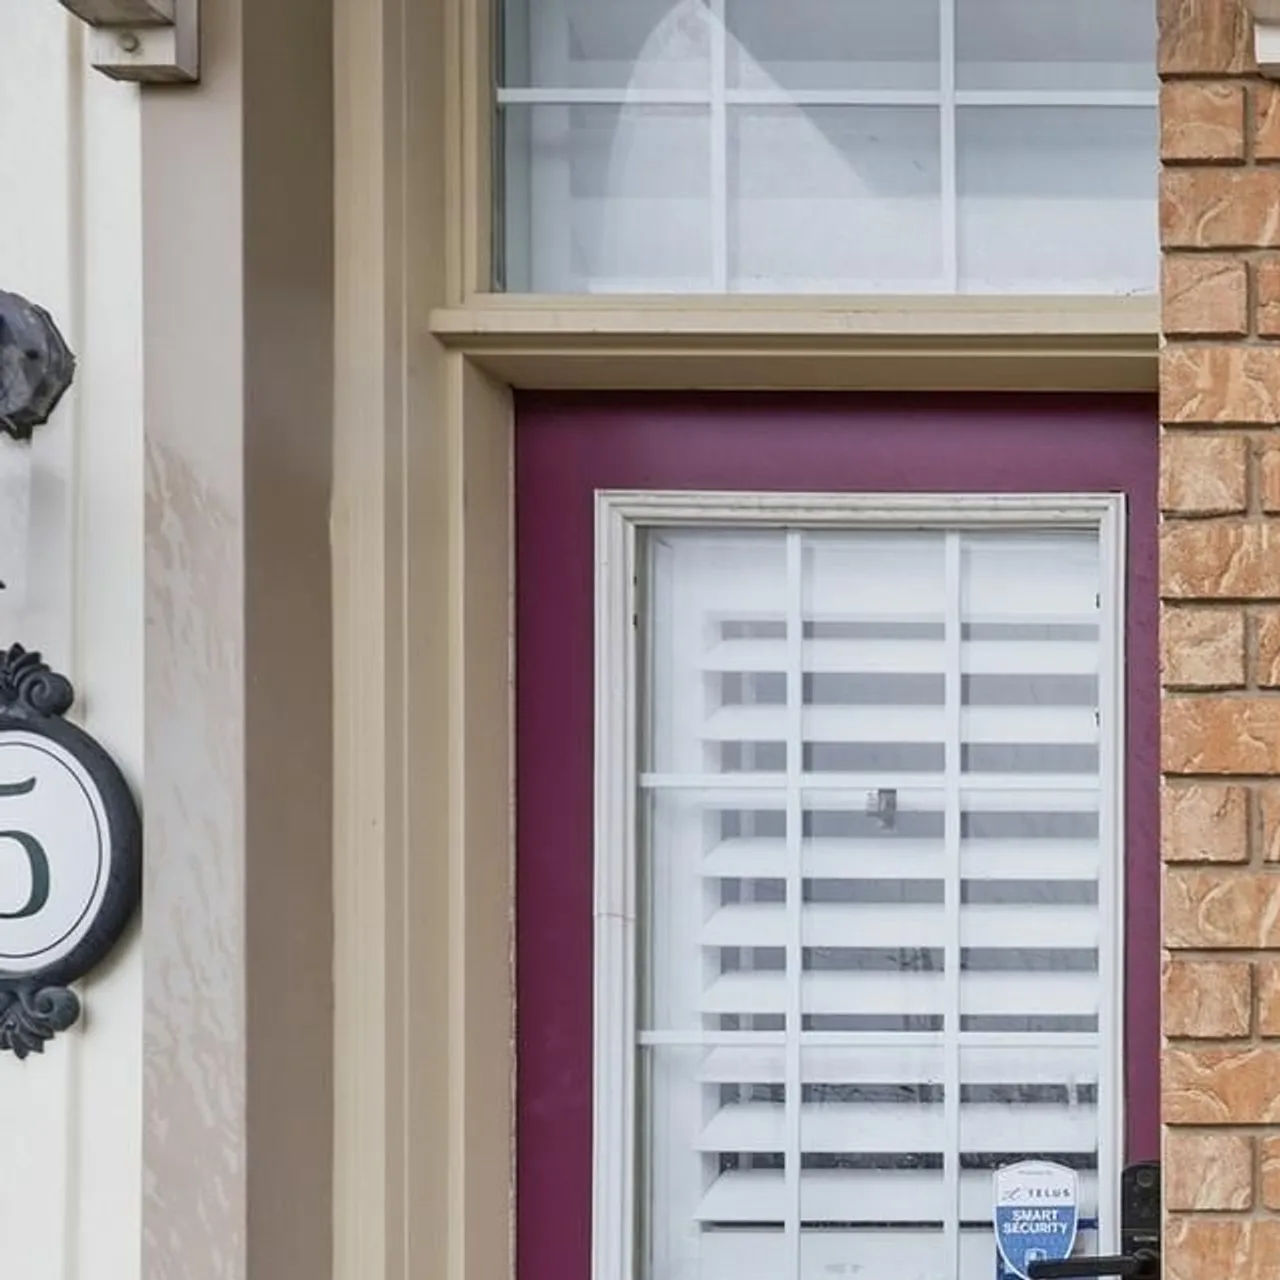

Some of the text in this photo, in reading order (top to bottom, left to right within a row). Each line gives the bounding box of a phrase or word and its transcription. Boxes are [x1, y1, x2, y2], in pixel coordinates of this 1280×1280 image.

[0, 777, 50, 919] 5
[1028, 1187, 1071, 1198] TELUS
[1012, 1209, 1058, 1221] SMART
[1003, 1222, 1068, 1235] SECURITY
